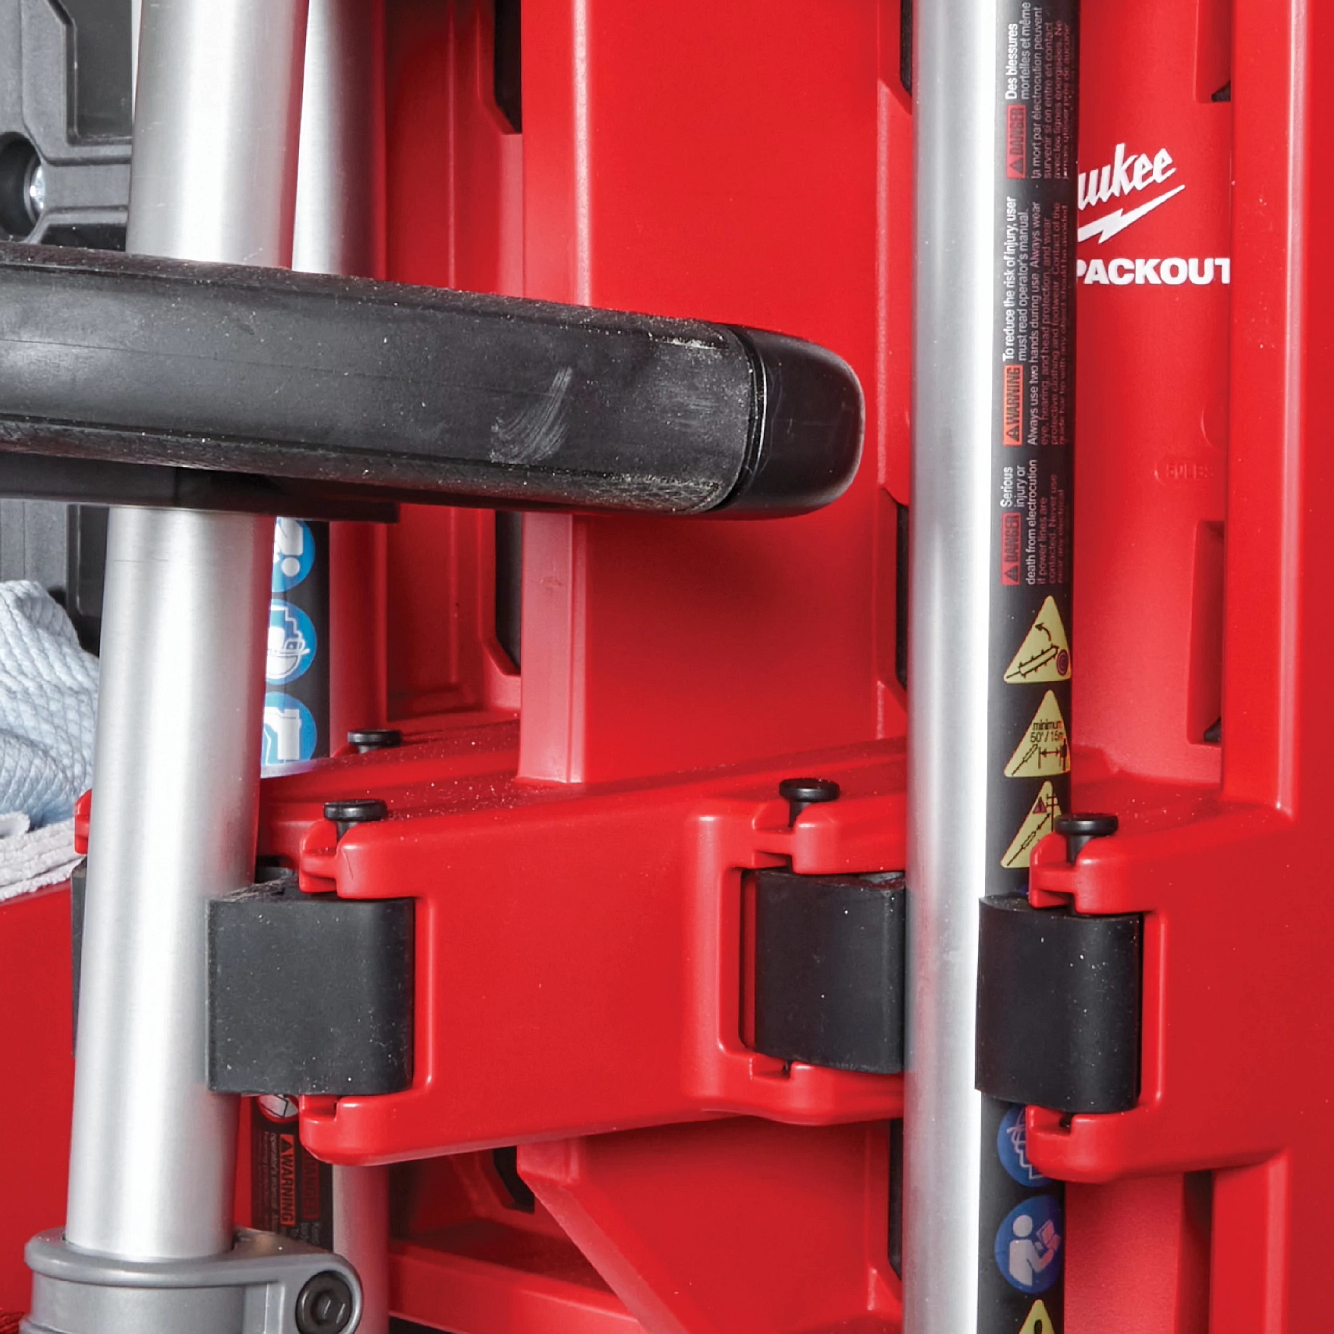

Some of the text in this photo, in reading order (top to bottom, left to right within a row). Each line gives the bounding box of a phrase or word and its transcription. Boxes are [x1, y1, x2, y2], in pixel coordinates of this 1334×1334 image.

[1005, 23, 1018, 100] Des blessures
[1019, 2, 1031, 100] mortelles et même
[1031, 6, 1044, 179] la mort par électrocution peuvent
[1044, 22, 1053, 179] survenir si on entre en contact
[1010, 108, 1024, 155] DANGER
[1002, 196, 1018, 362] To reduce the risk of injury, user
[1017, 209, 1029, 361] must read operator's manual.
[1042, 247, 1051, 266] and
[1027, 202, 1041, 445] Always use two hands during Always wear
[1041, 327, 1049, 353] head
[1050, 202, 1060, 445] protective clothing and Contact the
[1040, 355, 1049, 375] and
[1006, 368, 1020, 425] WARNING
[1000, 467, 1013, 507] Serious
[1014, 465, 1027, 507] injury or
[1049, 496, 1057, 527] Never
[1025, 460, 1037, 585] death from electrocution
[1038, 517, 1047, 541] lines
[1038, 543, 1048, 576] power
[282, 1155, 293, 1222] WARNING
